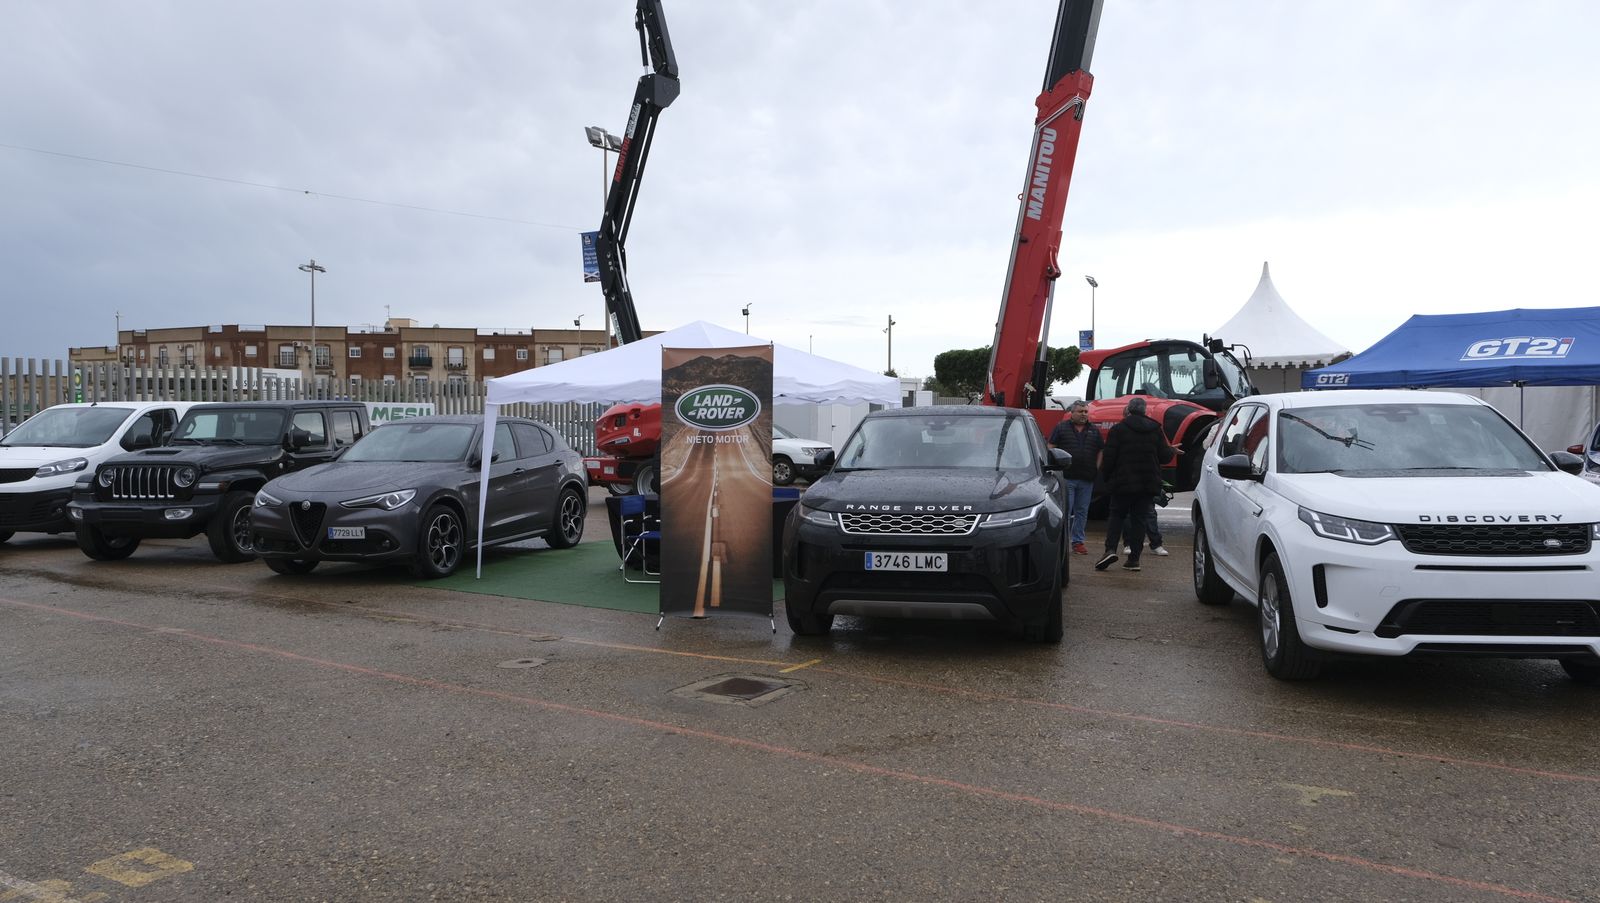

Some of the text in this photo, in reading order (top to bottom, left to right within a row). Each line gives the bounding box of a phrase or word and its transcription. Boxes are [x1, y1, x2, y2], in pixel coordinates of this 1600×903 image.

[1027, 127, 1057, 220] MANITOU
[1467, 338, 1572, 358] GT2i
[1317, 373, 1349, 384] GT2i
[693, 394, 733, 407] LAND
[696, 407, 745, 420] ROVER
[686, 434, 749, 444] NIETO MOTOR
[1419, 514, 1563, 523] DISCOVERY
[334, 529, 364, 537] 7729 LLY
[874, 555, 943, 569] 3746 LMC
